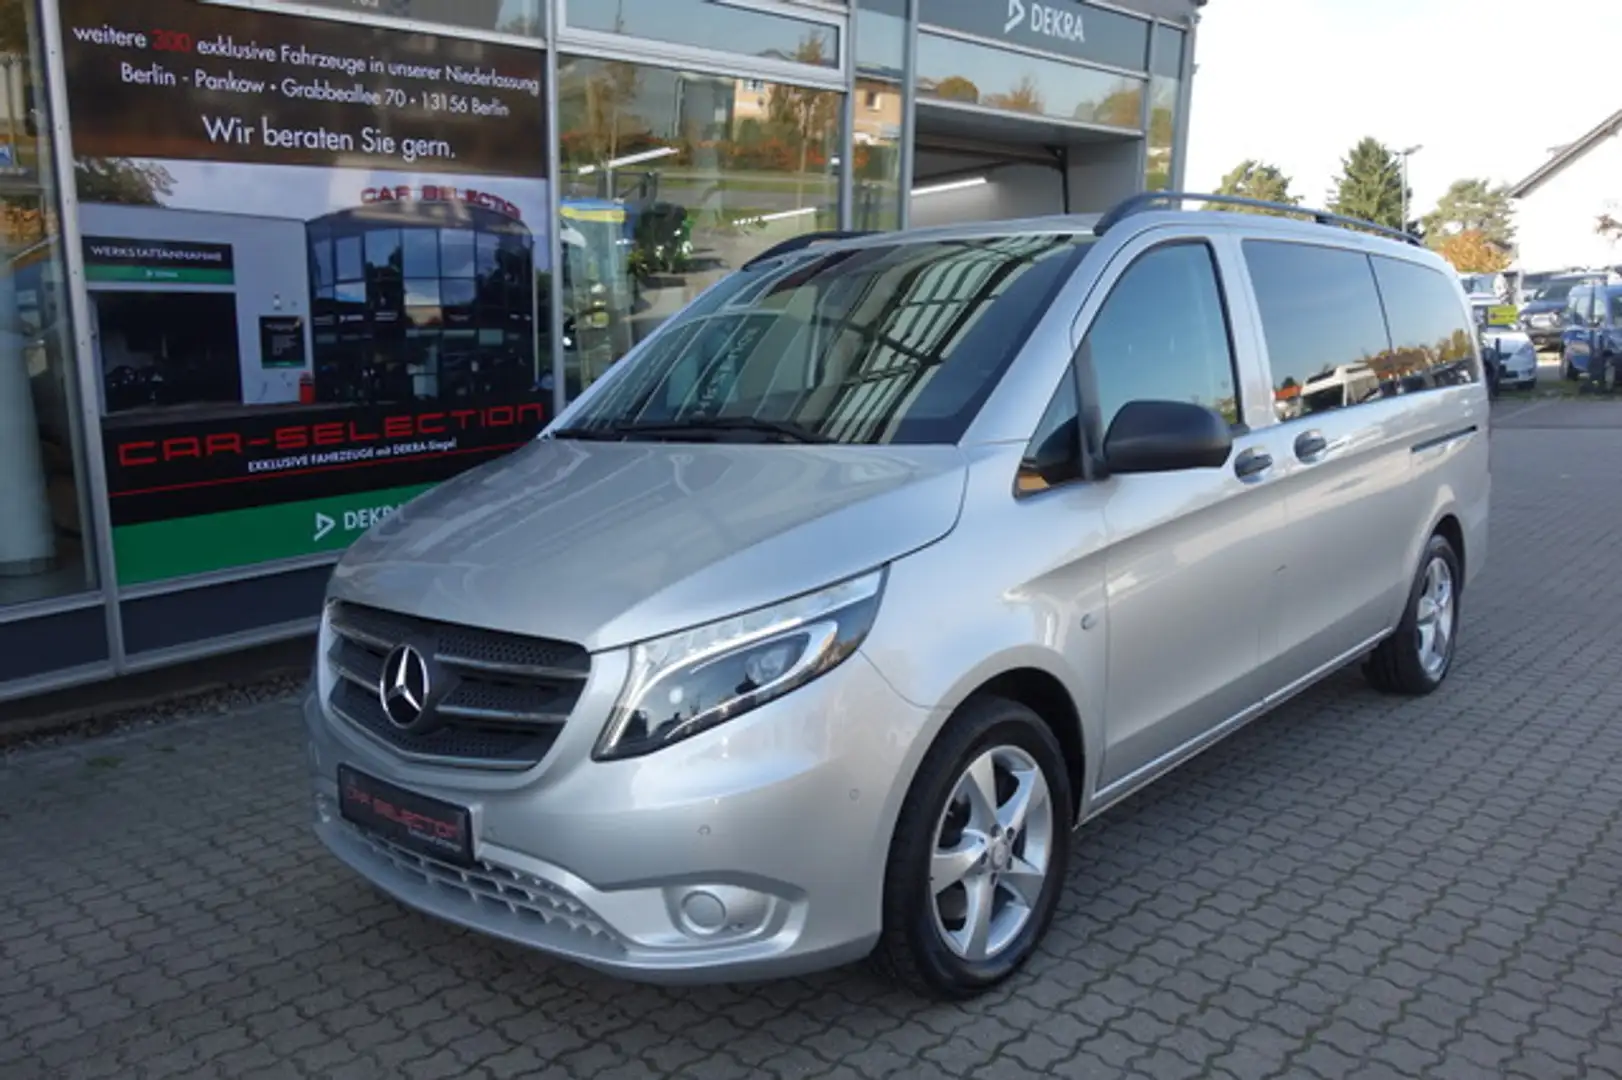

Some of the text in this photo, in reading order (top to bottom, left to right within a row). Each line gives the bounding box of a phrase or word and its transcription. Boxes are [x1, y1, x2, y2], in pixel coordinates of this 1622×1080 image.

[1030, 3, 1085, 42] DEKRA
[72, 24, 147, 48] weitere
[196, 35, 277, 63] exklusive
[280, 44, 366, 75] Fahrzeuge
[369, 56, 385, 74] in
[388, 62, 442, 80] unserer
[445, 65, 540, 96] Niederlassung
[120, 61, 177, 87] Berlin
[195, 68, 265, 93] Pankow
[281, 77, 381, 106] Grabbeallee
[385, 88, 407, 107] 70
[421, 91, 469, 113] 13156
[471, 96, 511, 117] Berlin
[202, 114, 457, 162] Wir beraten Sie gern.
[118, 403, 544, 467] CAR-SELECTION
[248, 452, 308, 473] EXKLUSIVE
[311, 446, 374, 463] FAHRZEUGE
[393, 441, 427, 455] DEKRA
